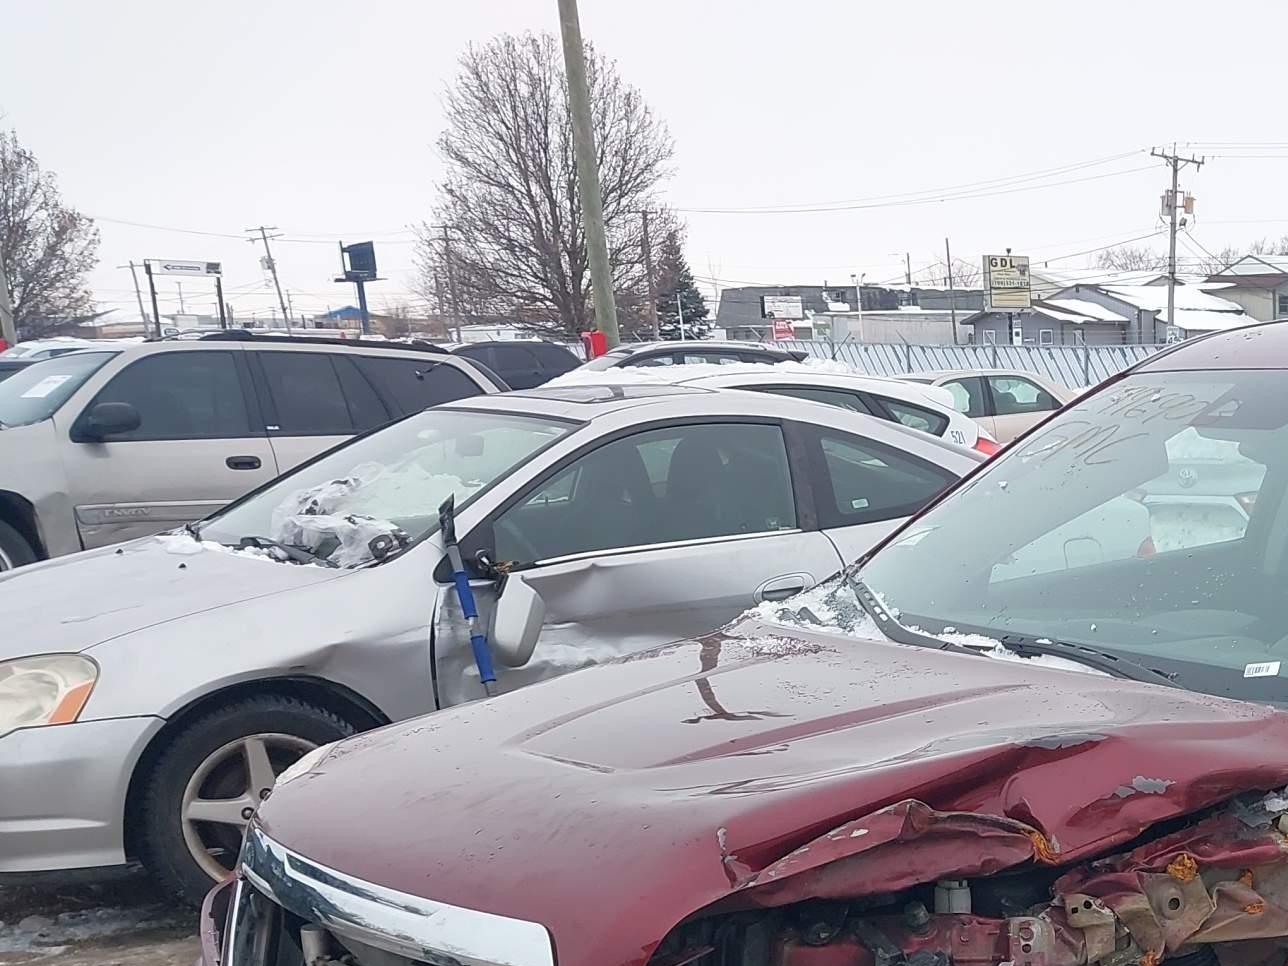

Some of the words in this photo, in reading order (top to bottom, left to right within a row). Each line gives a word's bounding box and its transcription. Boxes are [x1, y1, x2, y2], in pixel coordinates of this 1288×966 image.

[990, 257, 1016, 268] GDL
[950, 430, 966, 445] 521
[1014, 420, 1149, 466] GMC
